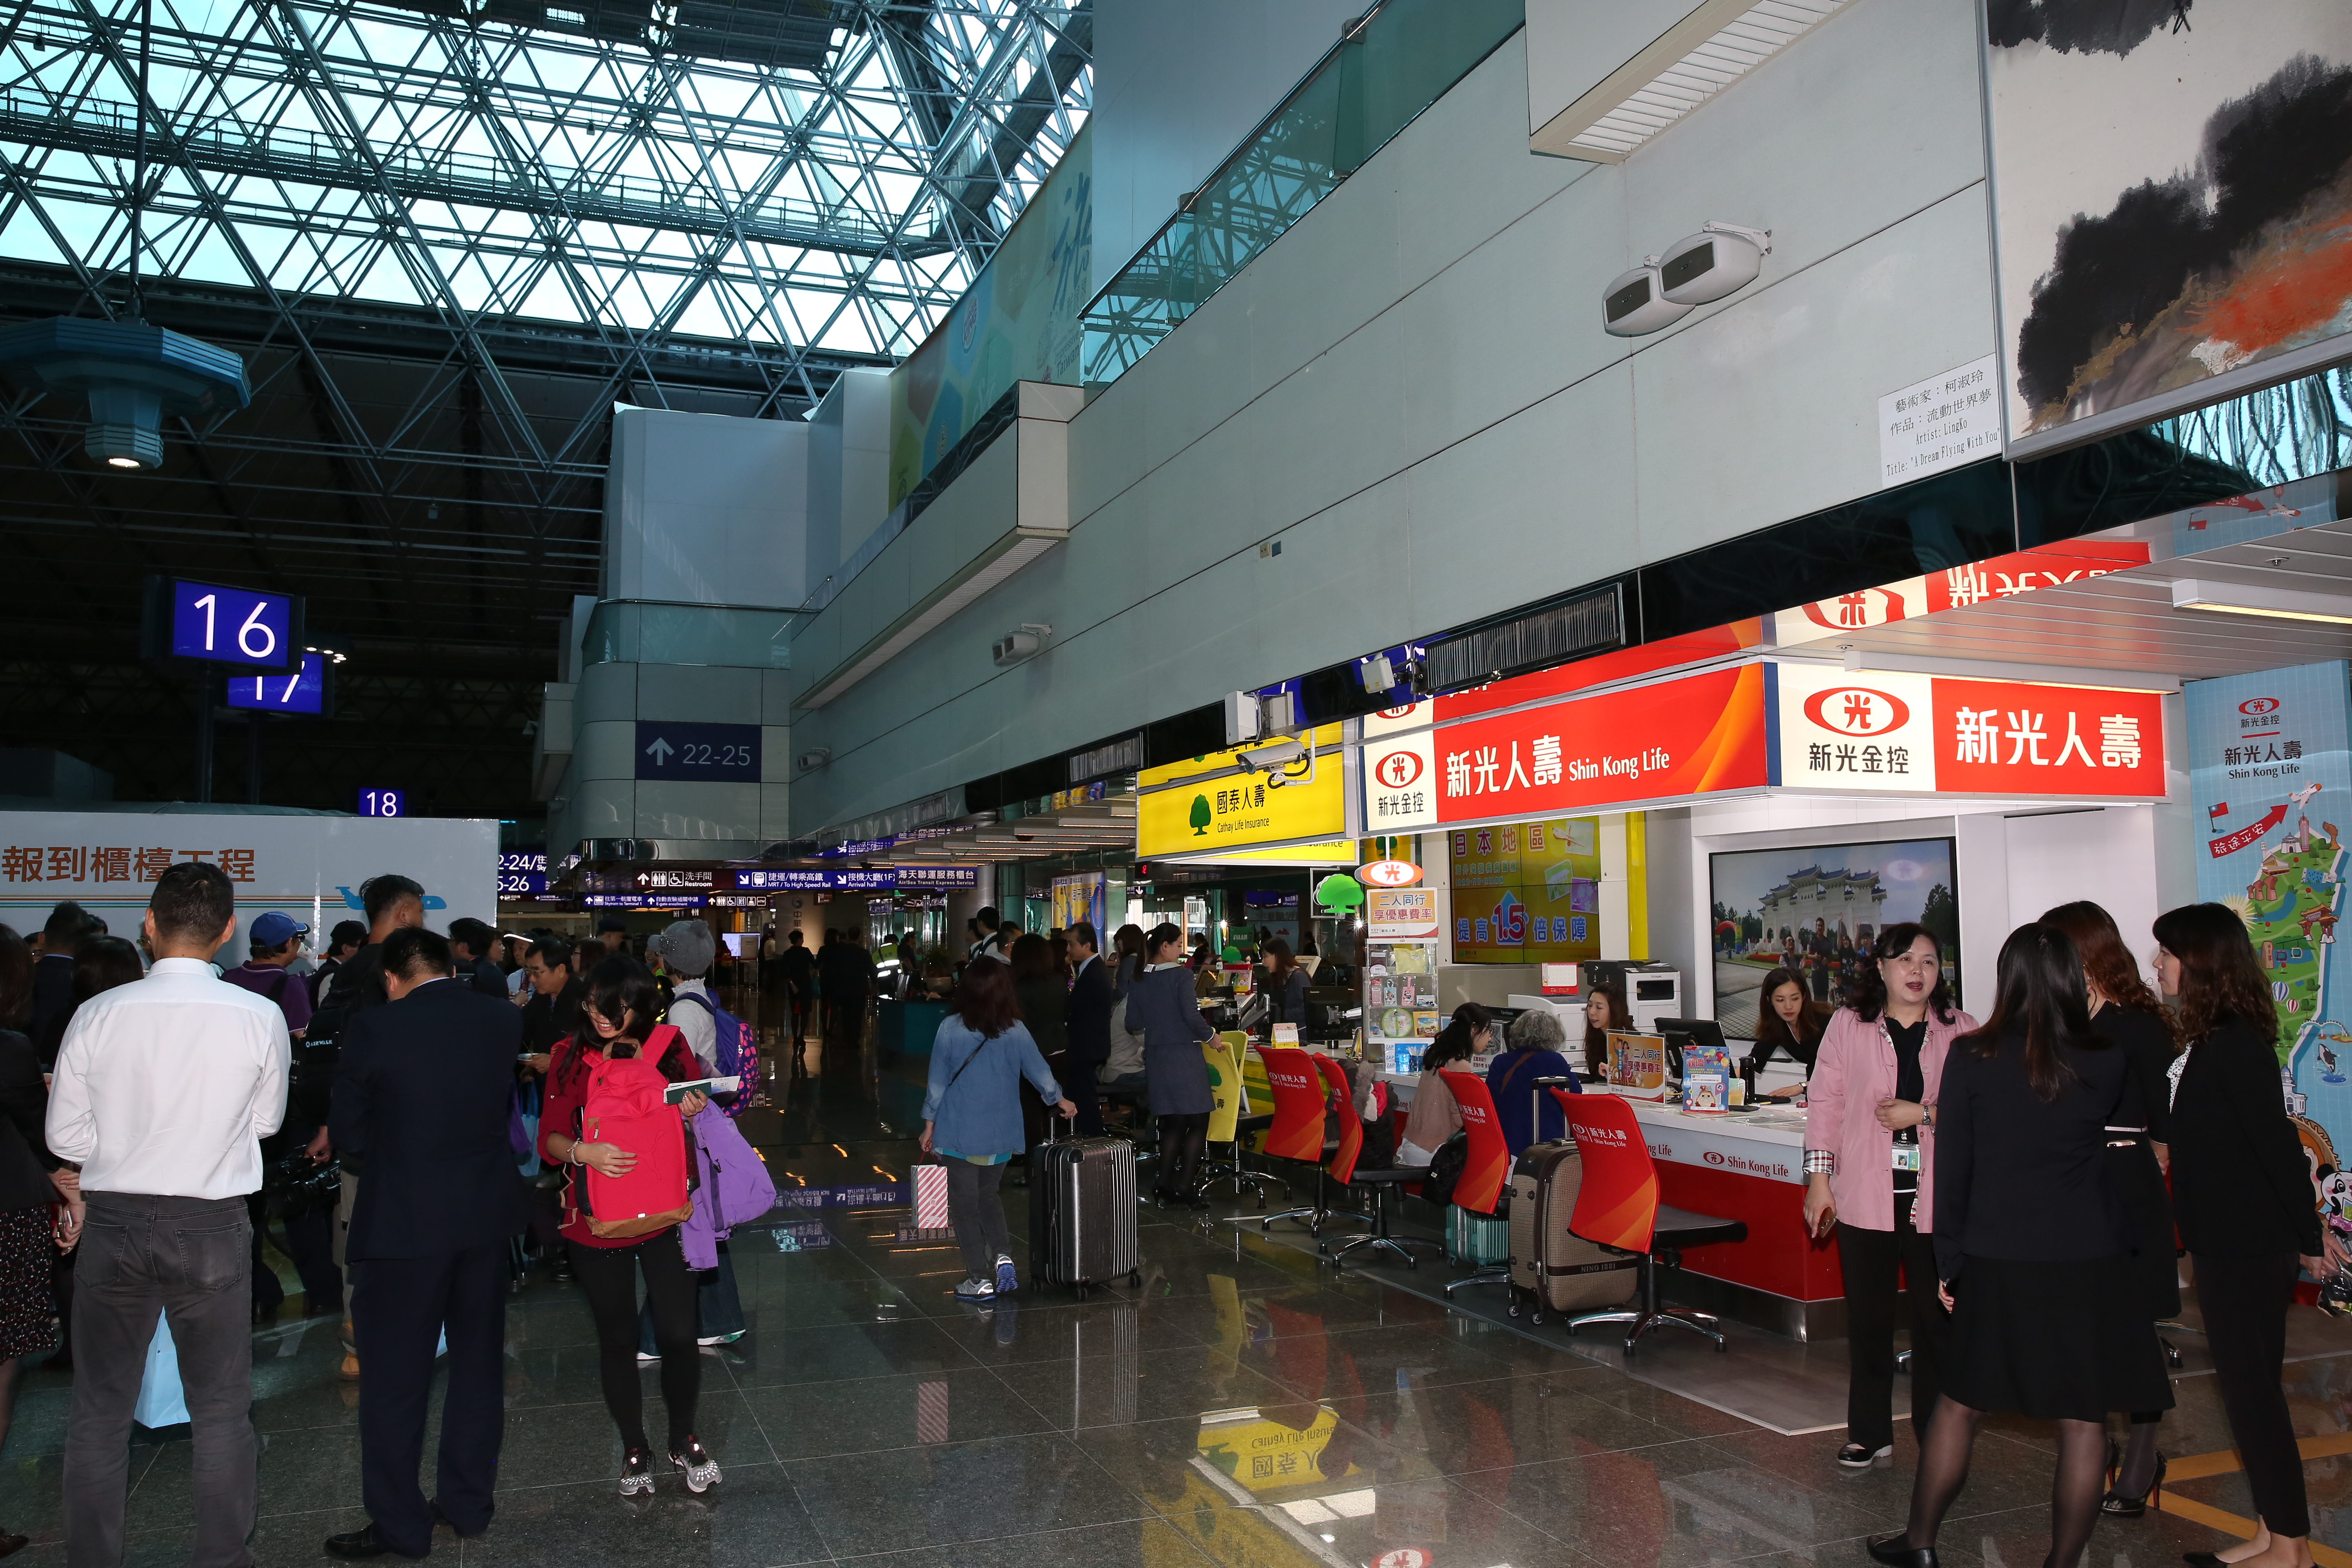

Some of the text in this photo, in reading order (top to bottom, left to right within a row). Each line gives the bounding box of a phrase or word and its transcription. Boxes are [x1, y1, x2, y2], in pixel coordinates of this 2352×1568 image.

[1056, 344, 1080, 379] Taiwan
[1915, 417, 1967, 445] Artist: LingKo
[1886, 461, 1908, 476] Title:
[1920, 452, 1939, 465] Dream
[1941, 443, 1964, 458] Flying
[1967, 434, 1983, 449] With
[194, 594, 276, 658] 16
[1844, 694, 1871, 729] 光
[2241, 715, 2280, 728] 新光金控
[1956, 706, 2141, 770] 新光人壽
[683, 744, 751, 766] 22-25
[1569, 747, 1670, 781] Shin Kong Life
[1809, 743, 1909, 774] 新光金控
[2225, 741, 2302, 766] 新光人壽
[1393, 758, 1405, 784] 光
[1447, 735, 1562, 798] 新光人壽
[2229, 764, 2300, 779] Shin Kong Life
[367, 792, 397, 817] 18
[1217, 784, 1264, 814] 國泰人壽
[1378, 791, 1424, 817] 新光金控
[1217, 817, 1270, 834] Cathay Life Insurance
[1454, 823, 1545, 857] 日本地區
[2214, 822, 2265, 855] 旅途平安
[685, 872, 712, 880] 洗手間
[768, 873, 824, 882] 捷運/轉乘高鐵
[898, 870, 974, 879] 海天聯運服務櫃台
[1385, 864, 1400, 882] 光
[1380, 894, 1425, 906] 二人同行
[1374, 909, 1432, 920] 享優惠費率
[1634, 1049, 1660, 1061] 二人同行
[1281, 1074, 1307, 1083] 新光人壽
[1627, 1060, 1661, 1074] 享優惠費率
[1589, 1127, 1626, 1140] 新光人壽
[1659, 1144, 1671, 1156] Life
[1728, 1156, 1788, 1177] Shin Kong Life
